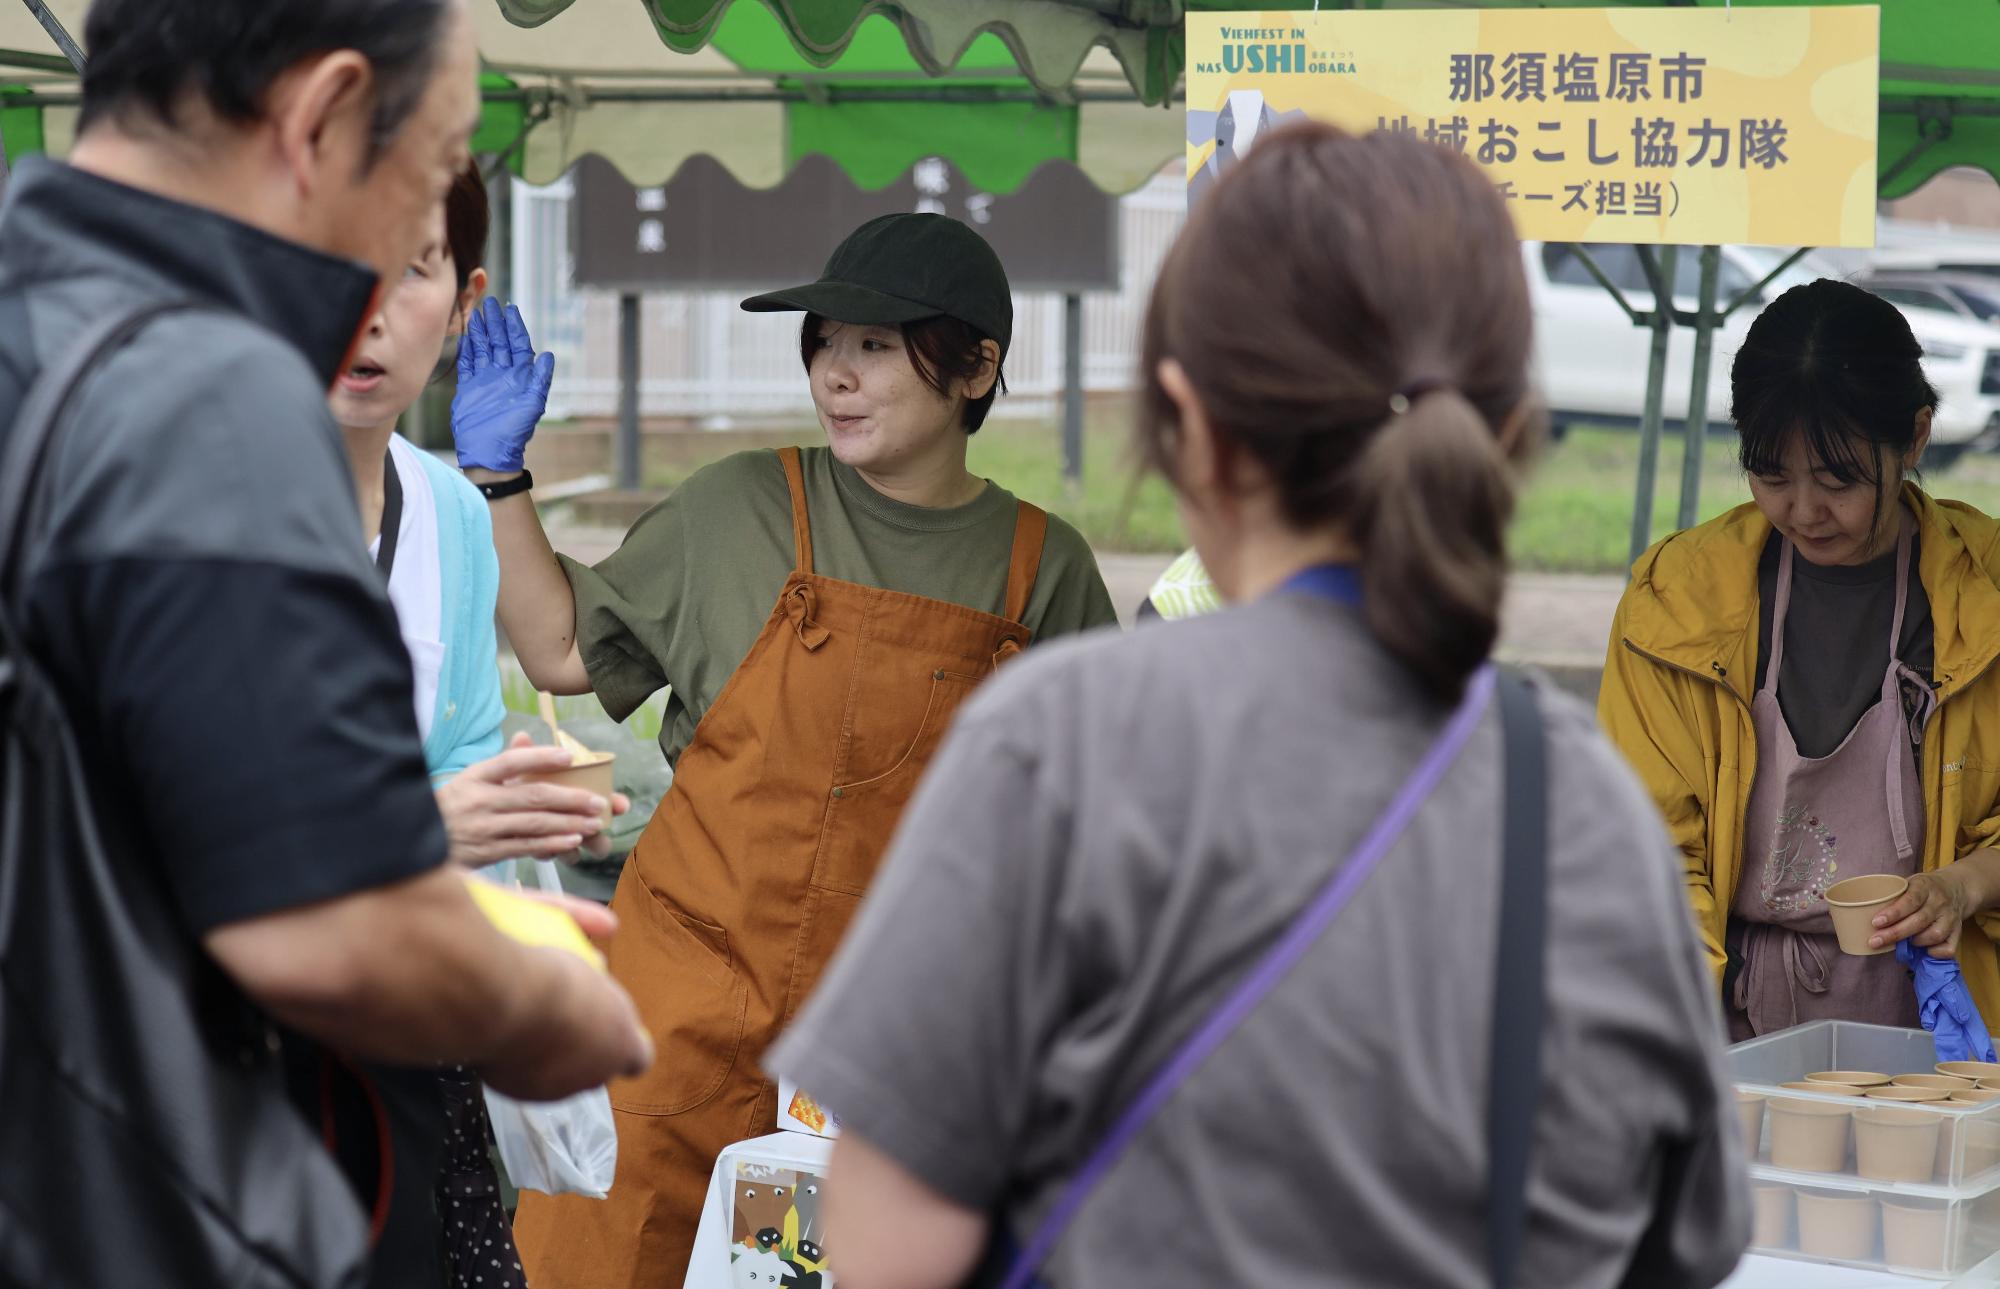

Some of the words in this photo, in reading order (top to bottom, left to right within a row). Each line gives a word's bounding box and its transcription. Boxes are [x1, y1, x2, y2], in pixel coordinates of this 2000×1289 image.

[1220, 27, 1285, 39] VIEHFEST
[1291, 28, 1305, 39] IN
[1449, 52, 1707, 103] 那須塩原市
